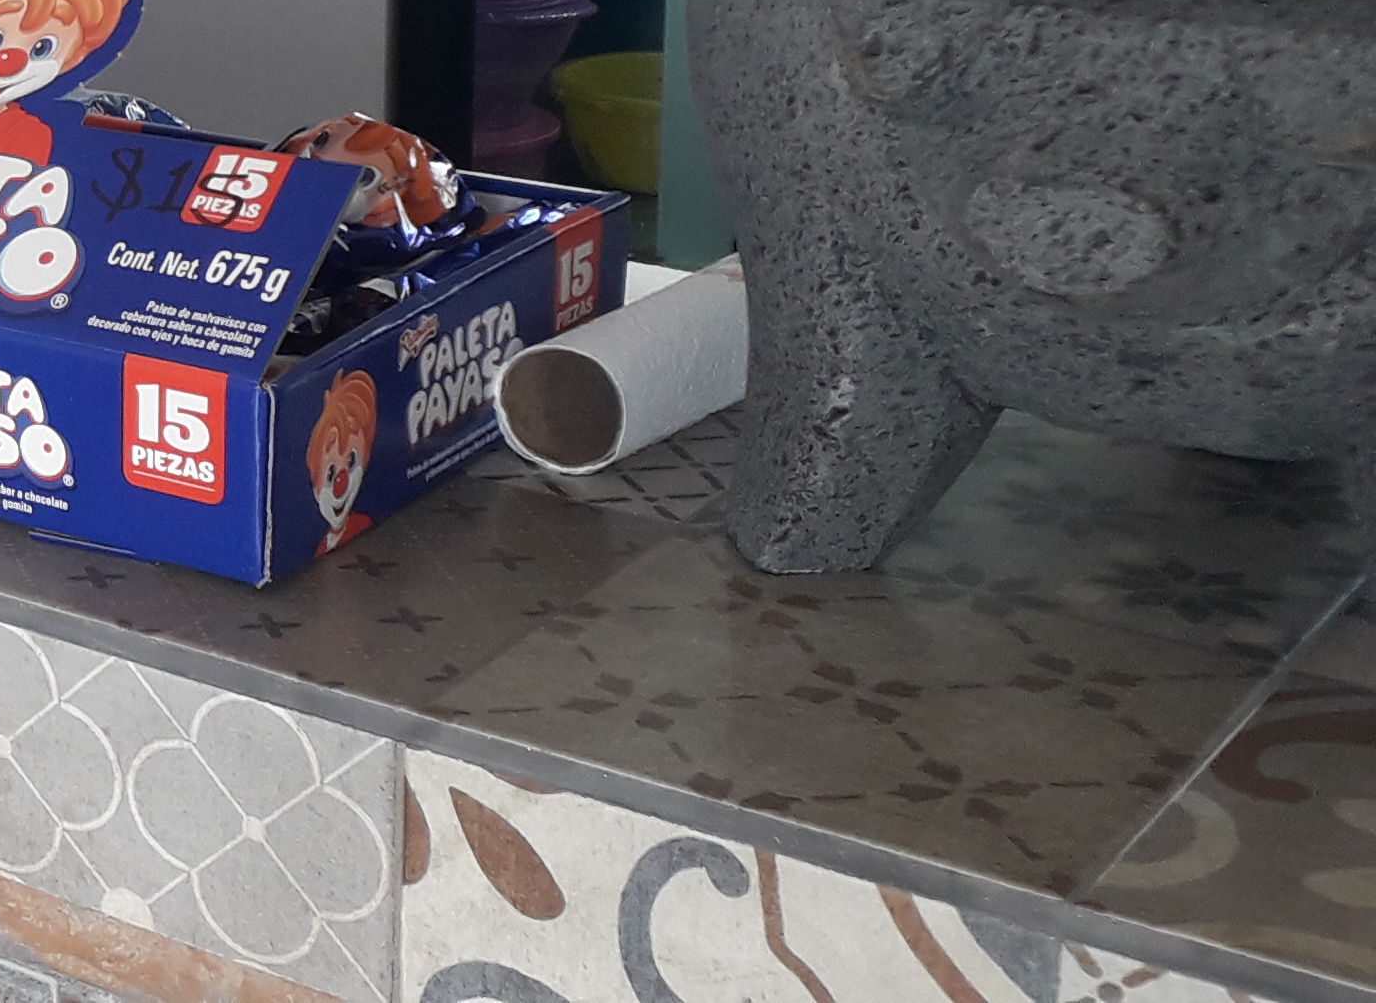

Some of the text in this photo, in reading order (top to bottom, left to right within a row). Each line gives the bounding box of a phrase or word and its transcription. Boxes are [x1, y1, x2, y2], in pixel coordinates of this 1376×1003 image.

[214, 153, 278, 199] 15
[107, 241, 156, 272] Cont.
[159, 250, 199, 280] Net.
[558, 239, 595, 305] 15
[87, 315, 256, 359] decorado con ojos y boca de gomita
[120, 310, 167, 327] cobertura
[167, 318, 194, 334] sabor
[204, 327, 253, 346] chocolate
[253, 336, 262, 349] y
[146, 300, 268, 334] Paleta de malvavisco con
[420, 300, 516, 389] PALETA
[407, 337, 524, 446] PAYAS
[135, 383, 210, 453] 15
[131, 444, 216, 484] PIEZAS
[2, 496, 33, 514] gomita
[25, 490, 69, 511] chocolate
